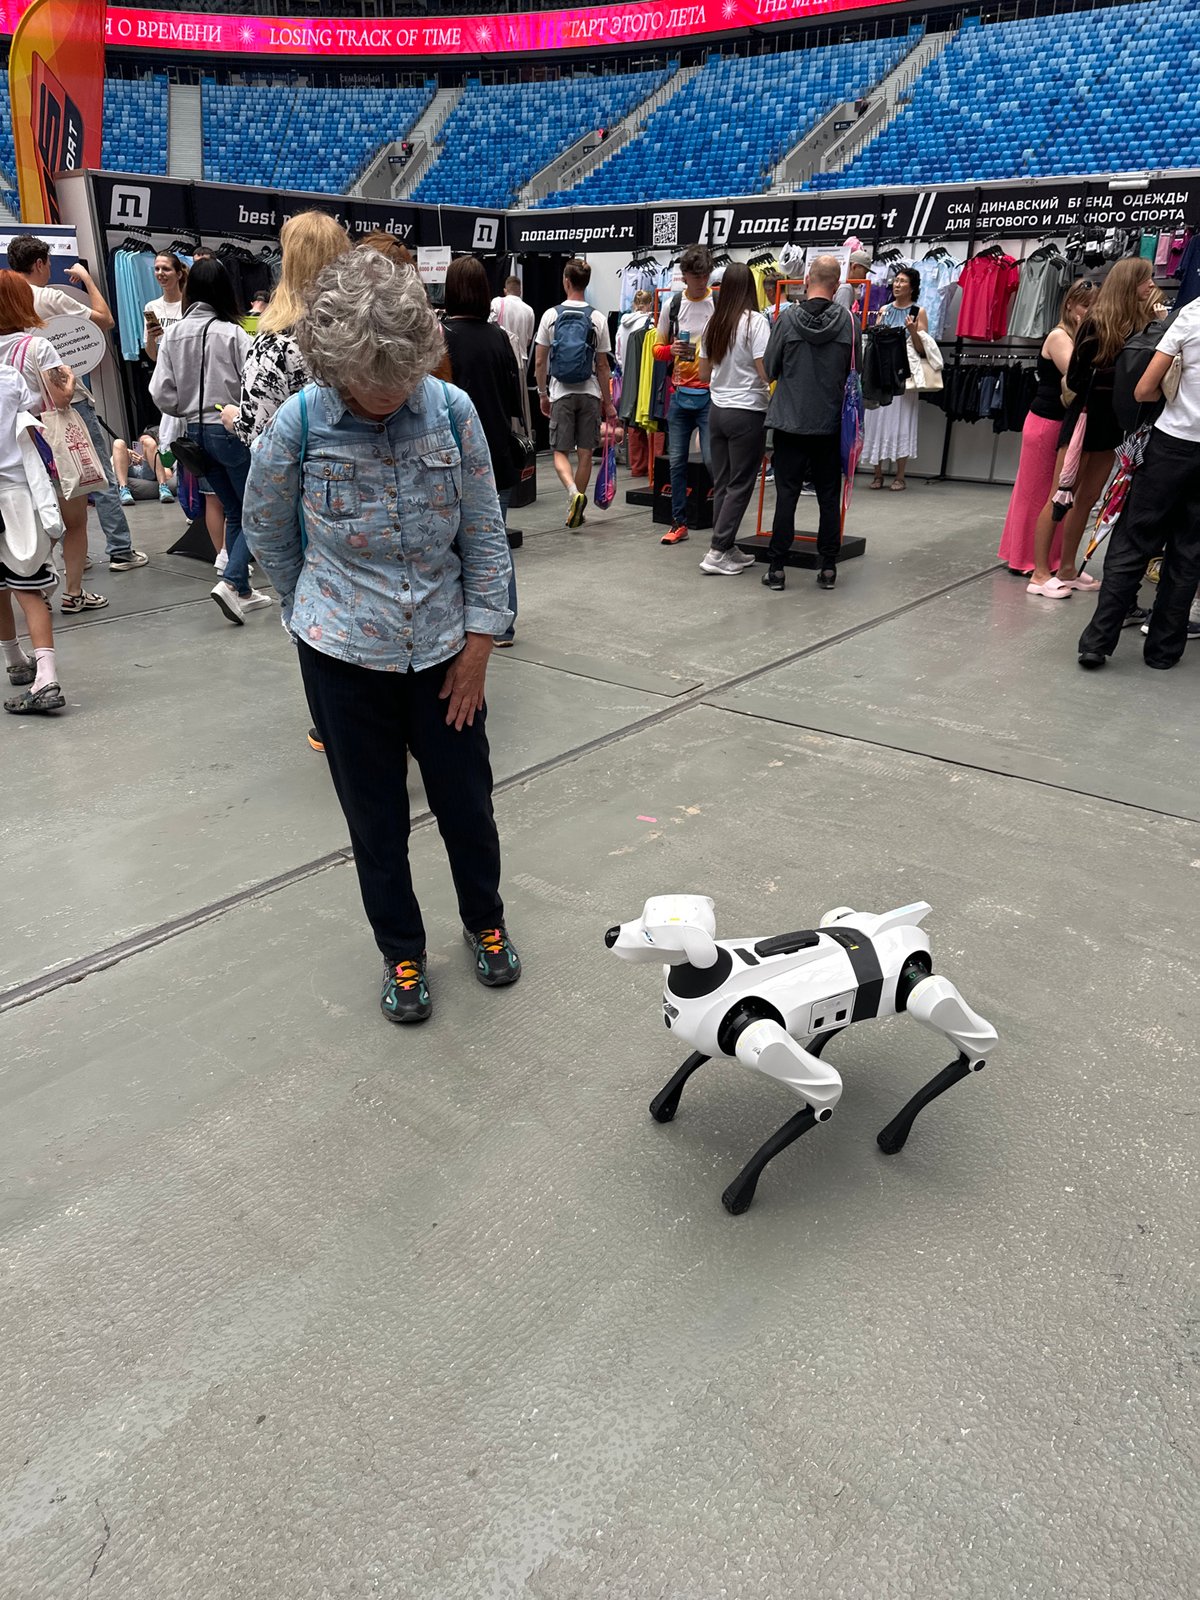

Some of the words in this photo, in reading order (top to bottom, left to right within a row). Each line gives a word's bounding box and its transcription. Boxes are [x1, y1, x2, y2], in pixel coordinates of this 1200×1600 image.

[118, 19, 132, 36] О
[137, 20, 222, 42] ВРЕМЕНИ
[610, 12, 663, 35] ЭТОГО
[665, 5, 706, 29] ЛЕТА
[269, 28, 332, 46] LOSING
[336, 28, 392, 47] TRACK
[396, 29, 419, 46] OF
[422, 28, 461, 46] TIME
[947, 196, 1059, 214] СКАДИНАВСКИЙ
[1122, 192, 1189, 207] ОДЕЖДЫ
[238, 205, 276, 226] best
[385, 218, 413, 239] day
[945, 218, 971, 231] ДЛЯ
[976, 215, 1038, 228] БЕГОВОГО
[1042, 215, 1052, 225] И
[1130, 208, 1185, 221] СПОРТА
